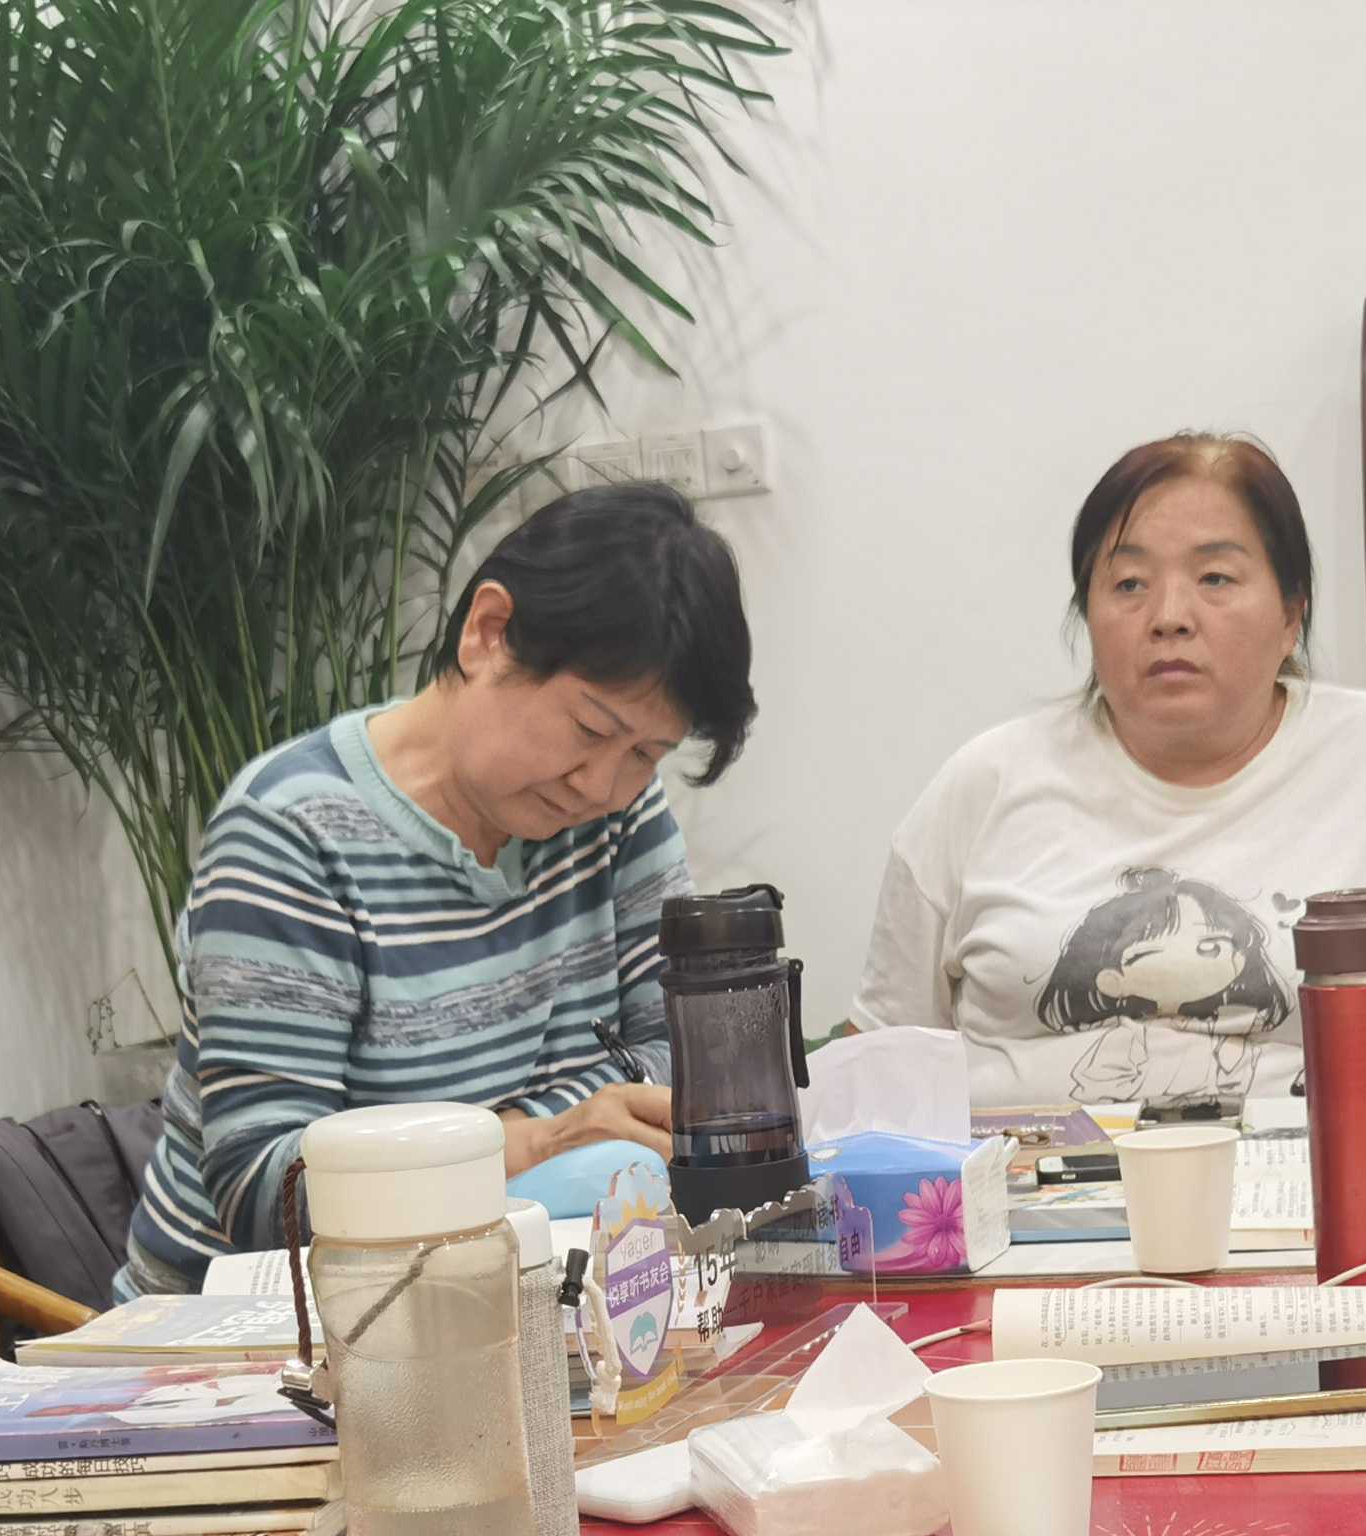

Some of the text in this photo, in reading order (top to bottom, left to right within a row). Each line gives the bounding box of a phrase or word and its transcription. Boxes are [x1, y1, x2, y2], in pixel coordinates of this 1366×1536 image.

[608, 1259, 671, 1308] 悦享听书友会
[24, 1456, 148, 1479] 成功的每日技巧
